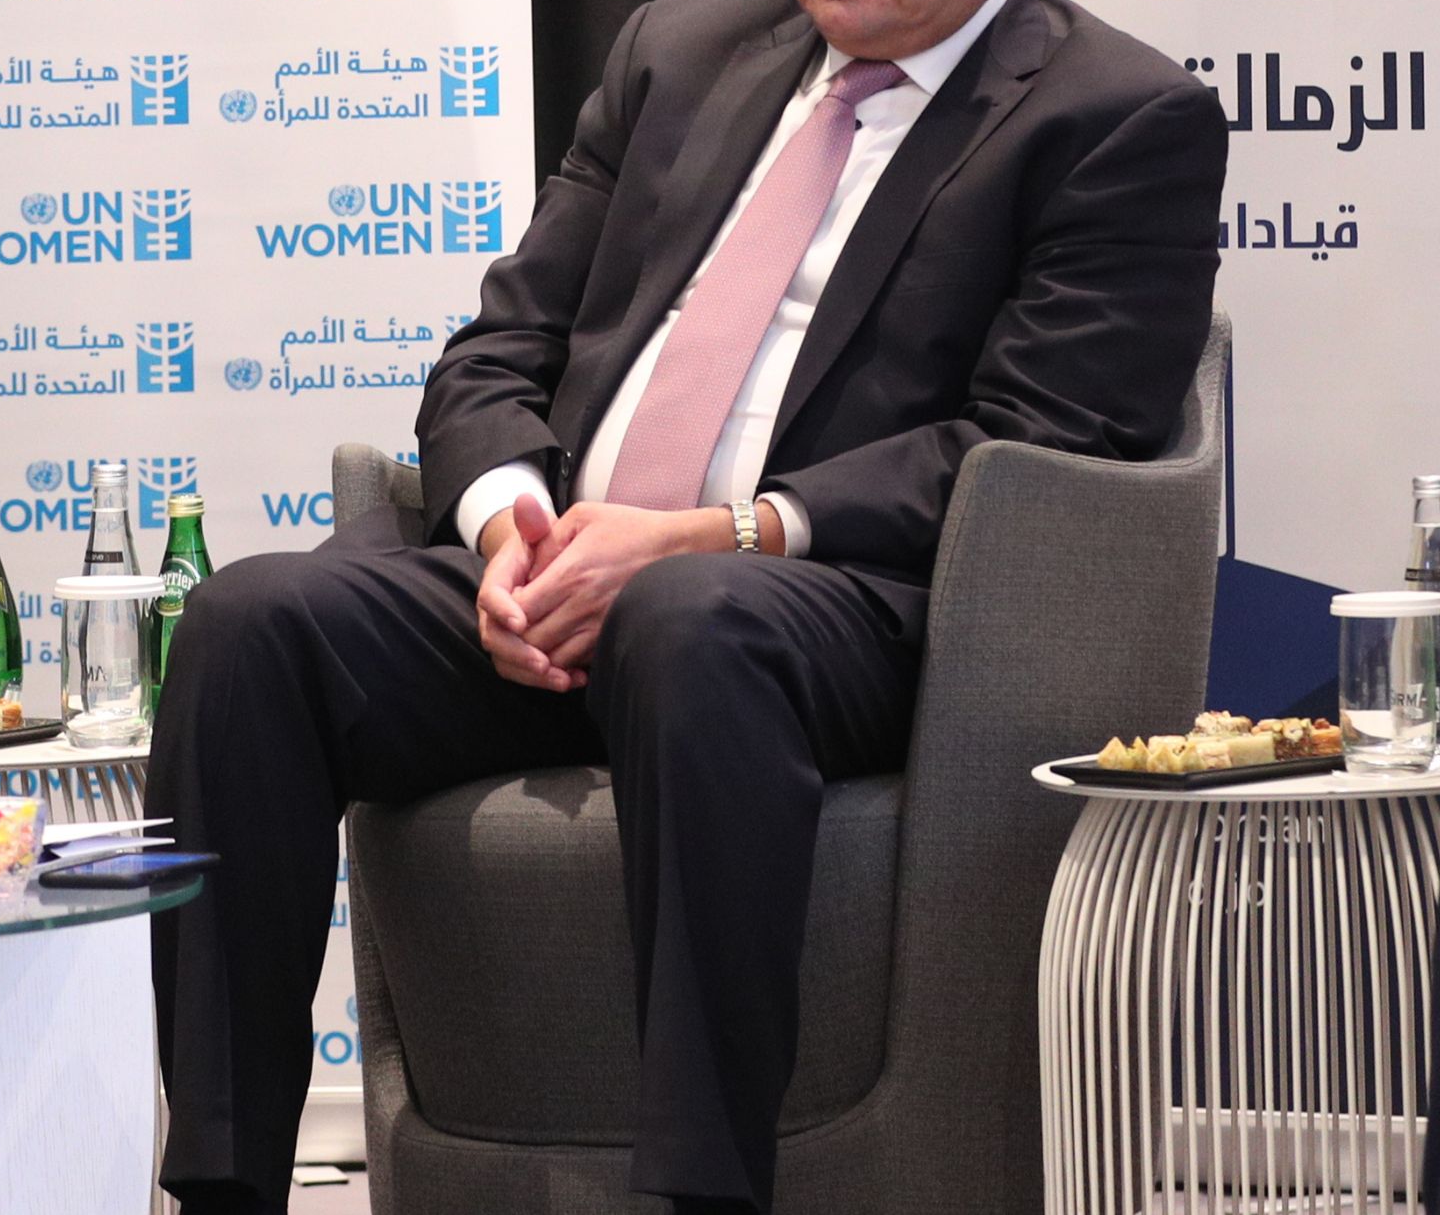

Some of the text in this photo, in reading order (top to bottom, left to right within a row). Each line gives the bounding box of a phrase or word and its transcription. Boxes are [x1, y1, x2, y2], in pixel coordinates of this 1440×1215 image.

[39, 58, 120, 89] هيئة
[275, 49, 430, 91] هيئة الأمم
[28, 102, 121, 130] المتحدة
[265, 91, 430, 129] المتحدة للمرأة
[60, 191, 125, 227] UN
[368, 180, 433, 218] UN
[255, 219, 434, 259] WOMEN
[43, 326, 126, 357] هيئة
[280, 315, 434, 357] هيئة الأمم
[33, 369, 126, 397] المتحدة
[269, 357, 336, 397] للمرأة
